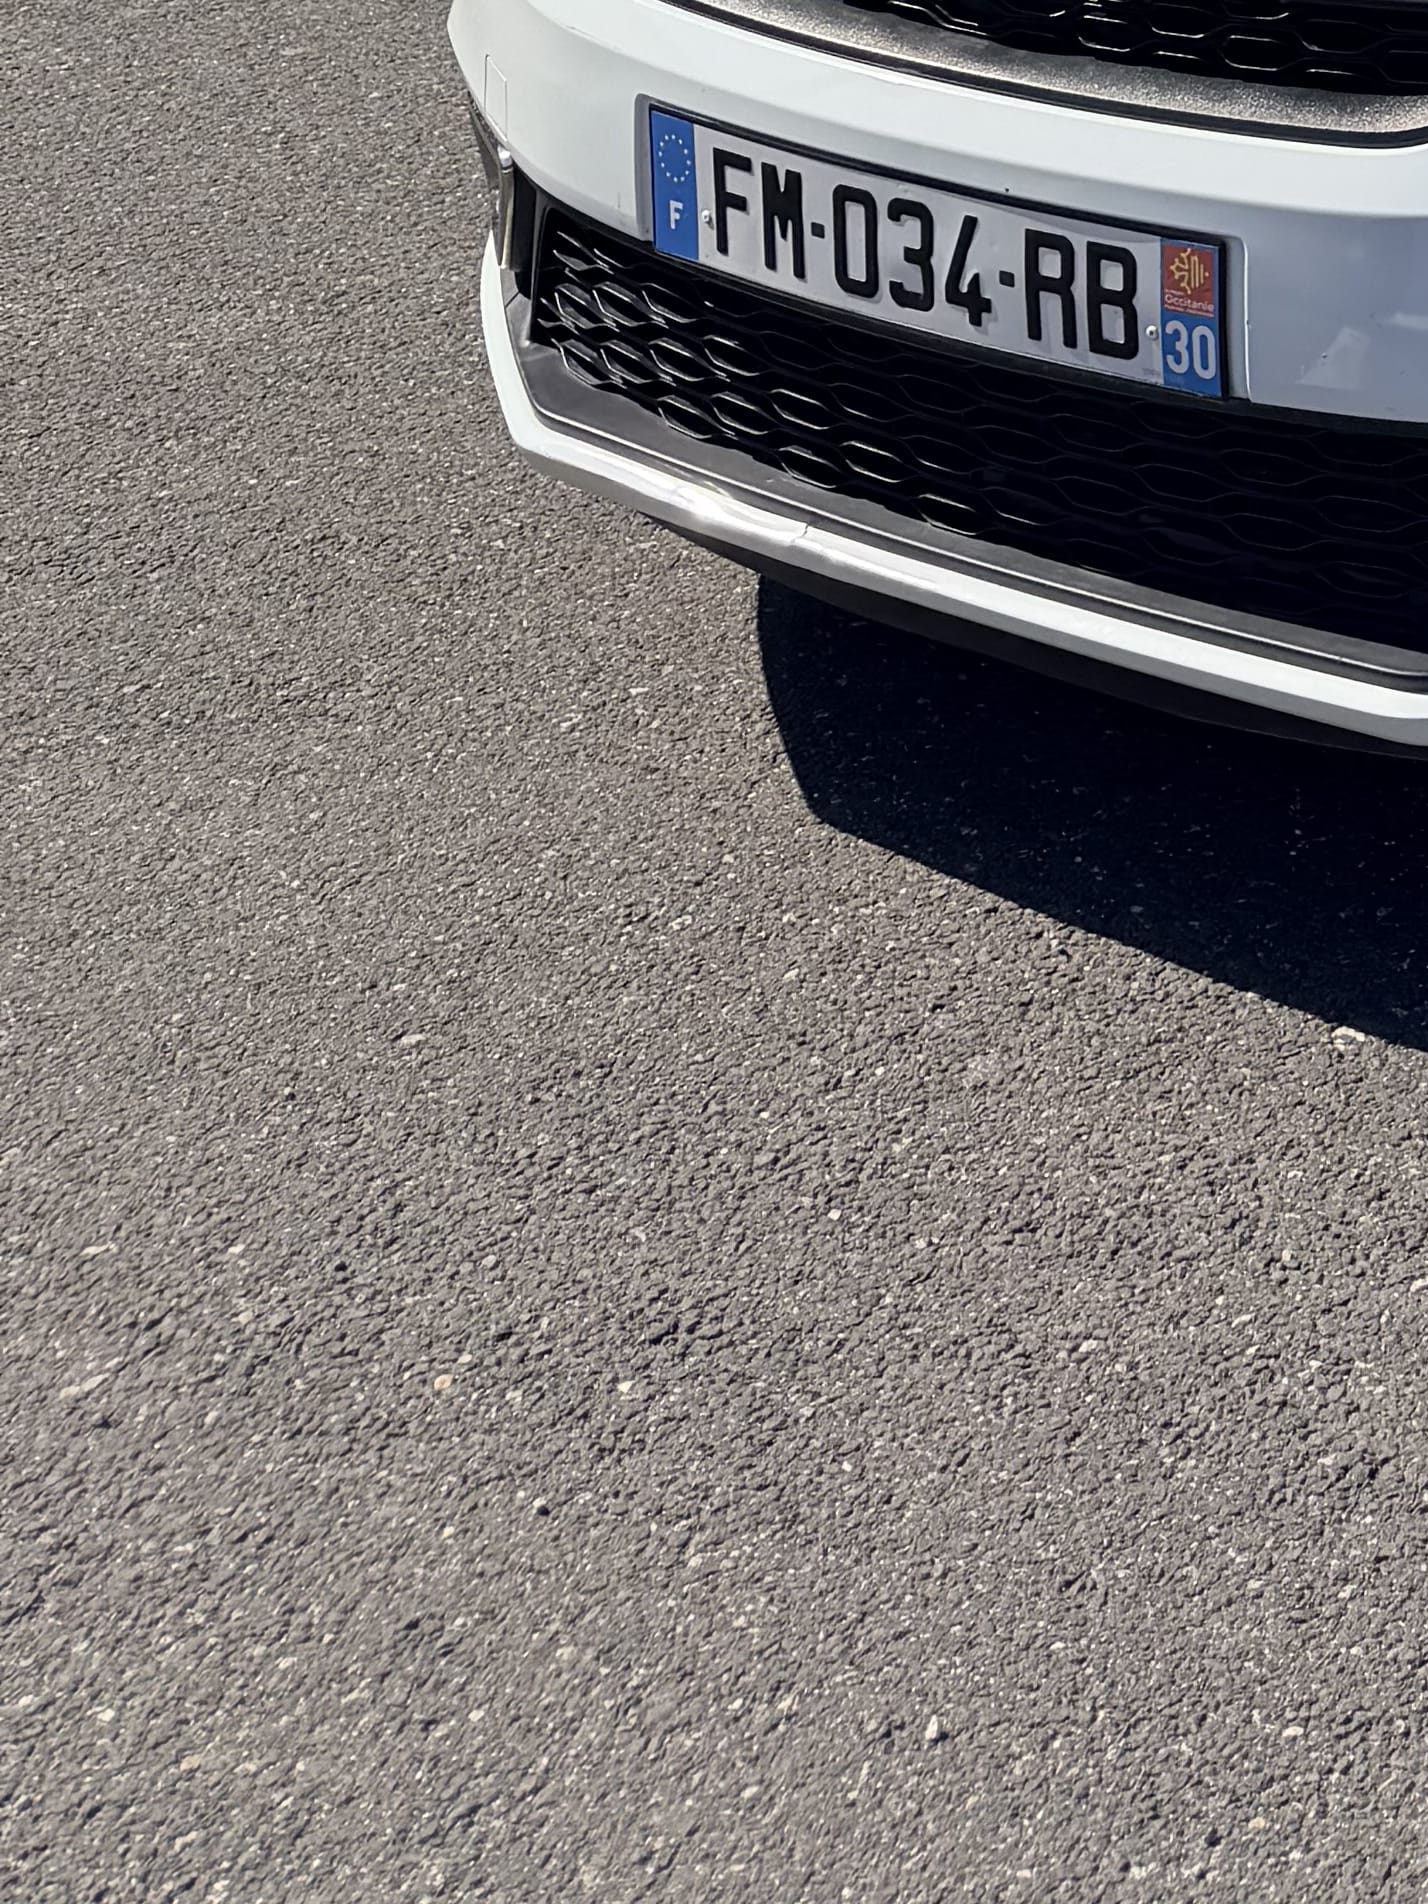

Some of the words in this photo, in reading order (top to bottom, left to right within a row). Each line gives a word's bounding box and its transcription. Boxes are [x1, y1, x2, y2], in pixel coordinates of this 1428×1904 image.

[668, 200, 684, 232] F
[712, 147, 1139, 360] FM-034-RB
[1164, 294, 1215, 312] Occitanie
[1165, 320, 1216, 380] 30
